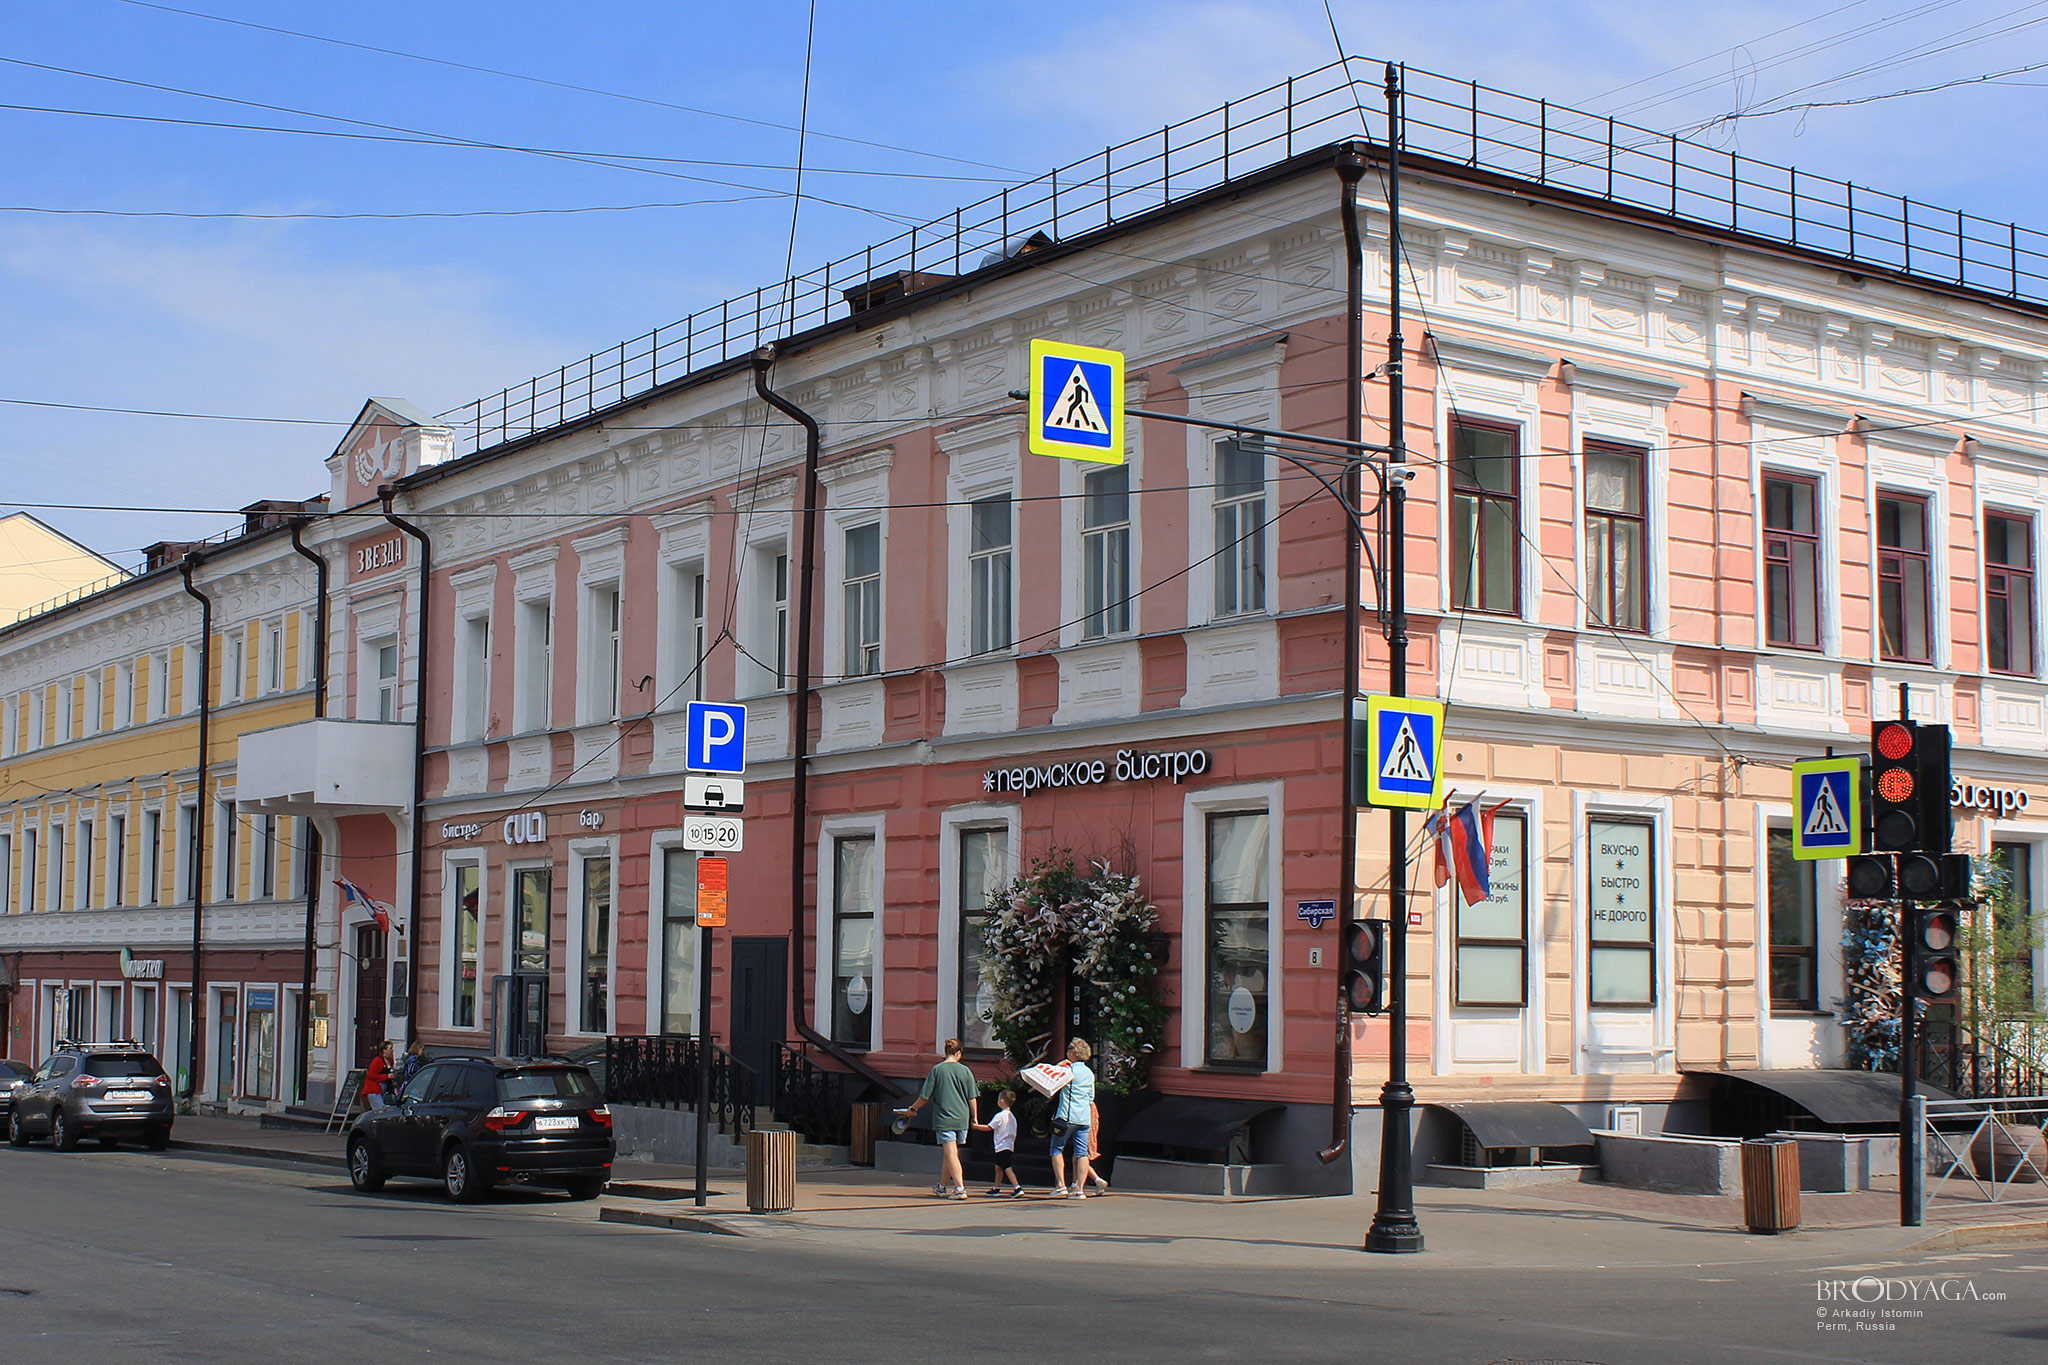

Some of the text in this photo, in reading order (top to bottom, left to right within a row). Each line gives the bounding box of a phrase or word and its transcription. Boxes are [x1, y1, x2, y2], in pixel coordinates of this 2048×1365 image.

[357, 537, 402, 574] ЗВЕЗДА
[702, 710, 736, 763] P
[998, 749, 1206, 797] пермское бистро
[580, 809, 601, 830] бар
[443, 823, 479, 841] бистро
[691, 828, 735, 842] 10 15 20
[1601, 843, 1639, 856] ВКУСНО
[1601, 877, 1640, 889] БЫСТРО
[1299, 907, 1333, 916] Сибирская
[1594, 910, 1647, 922] НЕ ДОРОГО
